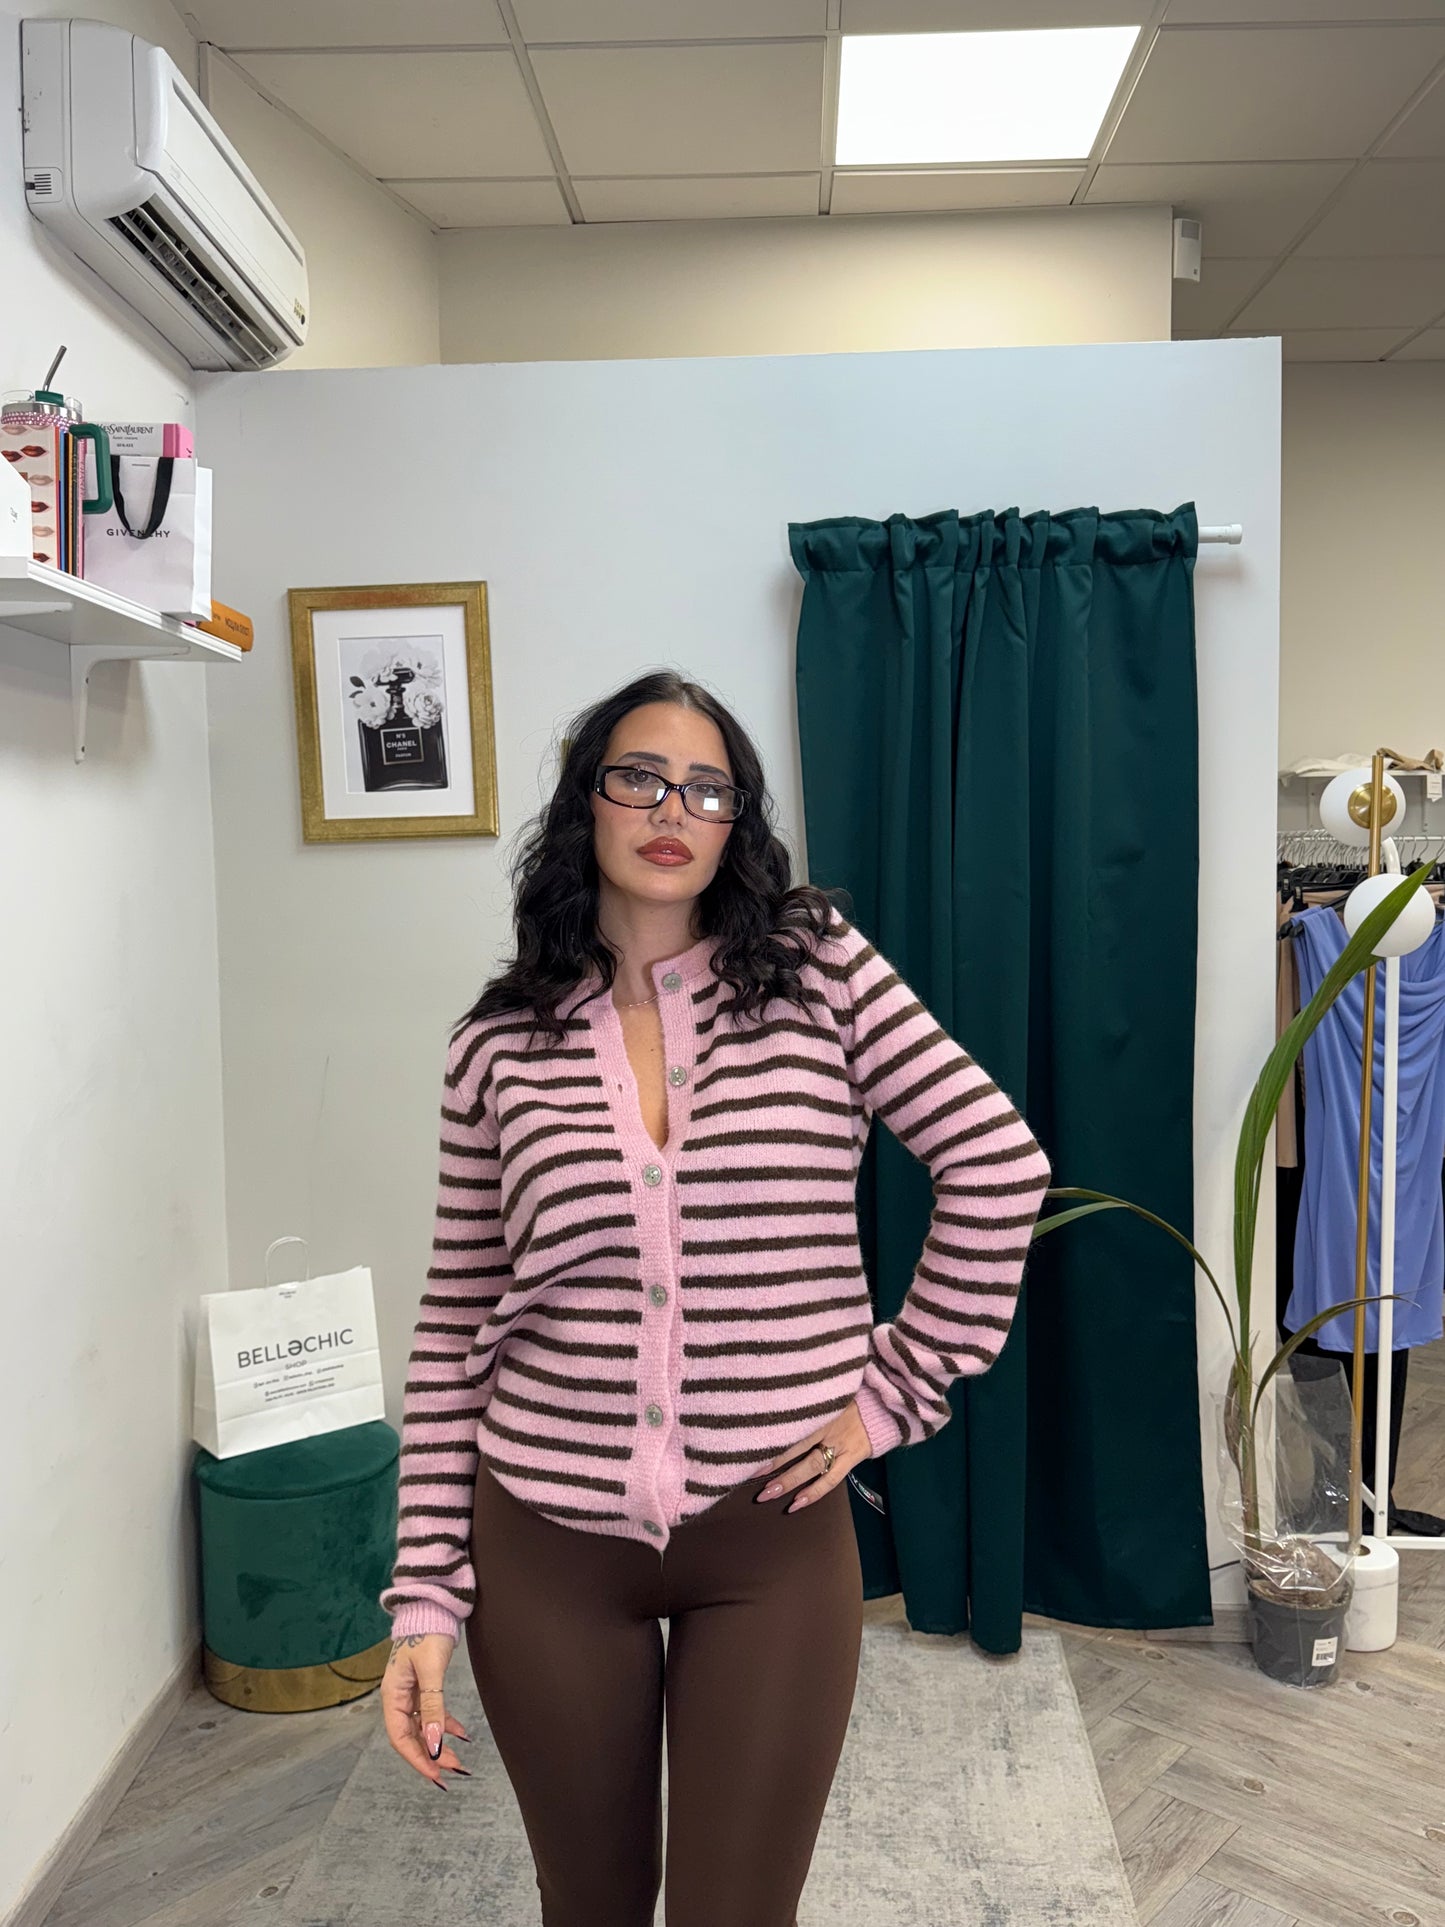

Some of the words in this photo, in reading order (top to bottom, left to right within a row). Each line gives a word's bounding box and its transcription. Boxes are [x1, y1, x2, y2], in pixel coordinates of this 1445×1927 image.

[106, 528, 170, 537] GIVENHY
[386, 740, 417, 748] CHANEL
[285, 1360, 307, 1370] SHOP
